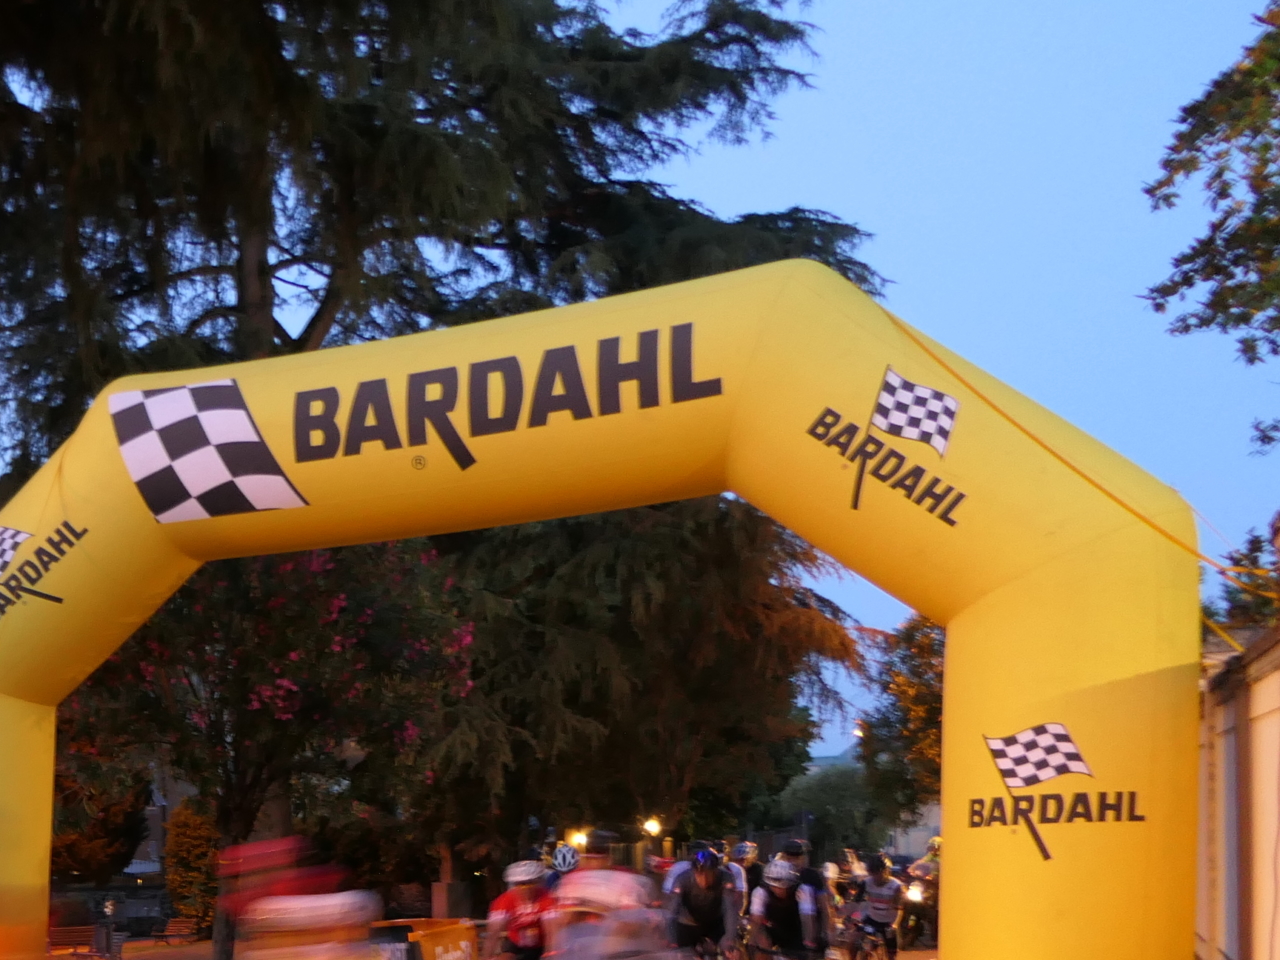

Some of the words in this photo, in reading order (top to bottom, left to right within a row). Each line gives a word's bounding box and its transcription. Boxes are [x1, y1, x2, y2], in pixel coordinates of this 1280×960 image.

[295, 322, 722, 471] BARDAHL
[806, 407, 968, 527] BARDAHL
[968, 791, 1145, 860] BARDAHL
